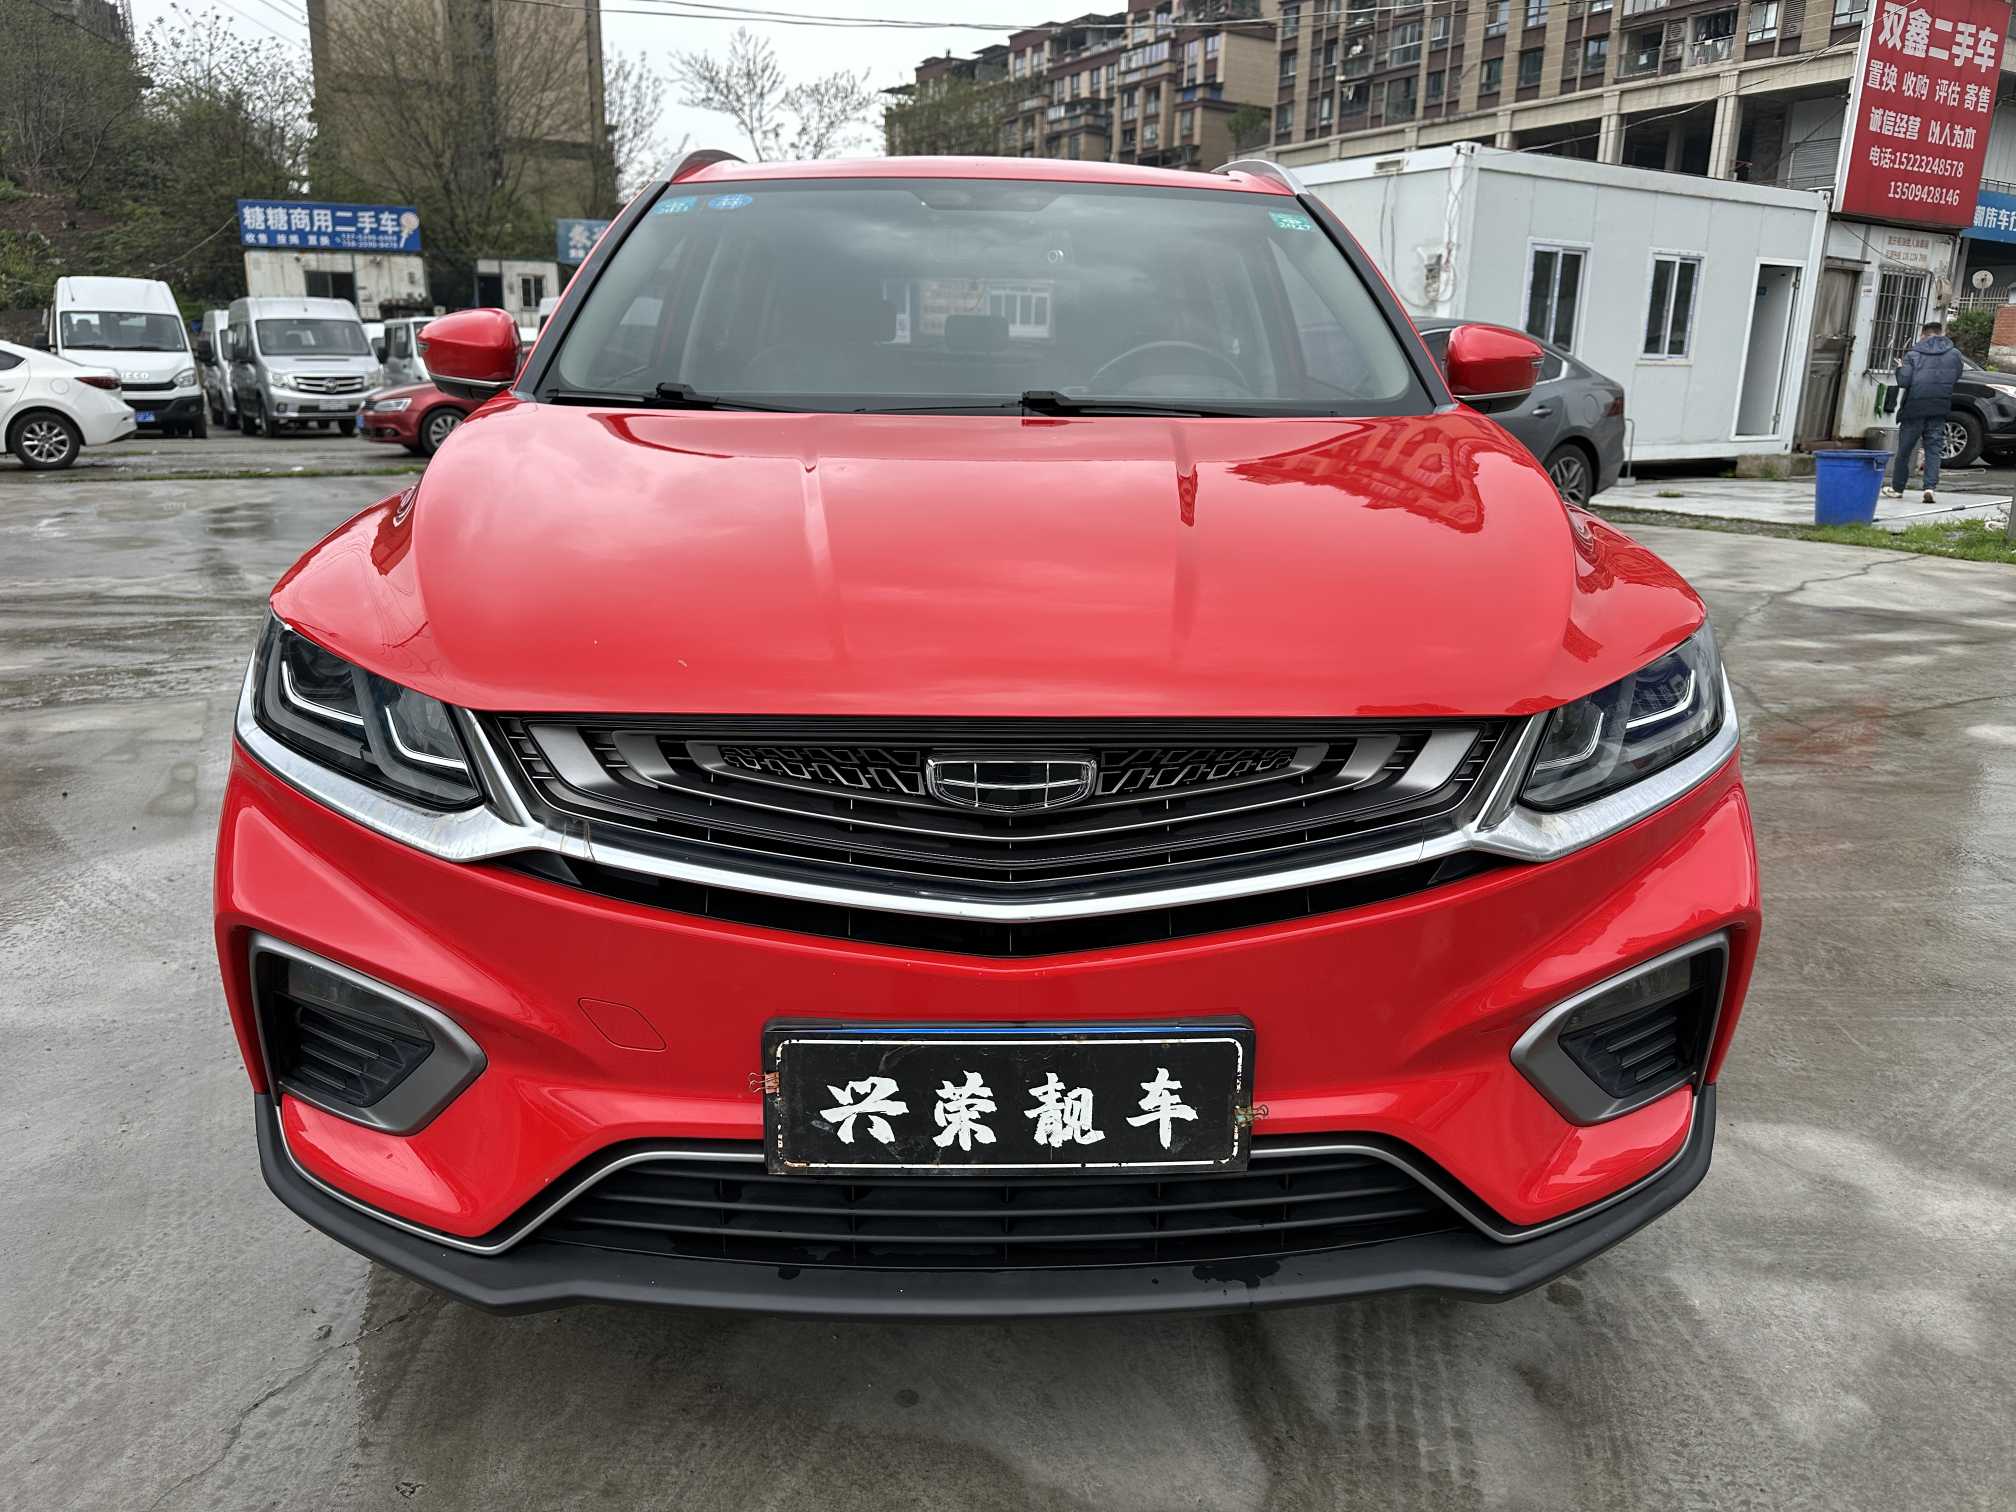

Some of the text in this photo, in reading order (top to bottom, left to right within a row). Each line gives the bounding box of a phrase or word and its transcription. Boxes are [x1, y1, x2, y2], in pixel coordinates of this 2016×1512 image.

[1878, 1, 1999, 73] 双鑫二手车
[1866, 59, 1992, 114] 置换 收购 评估 寄售
[1869, 106, 1977, 150] 诚信经营 以人为本
[1887, 181, 1960, 206] 13509428146
[242, 206, 400, 235] 糖糖商用二手车
[820, 1067, 1199, 1150] 兴荣靓车
